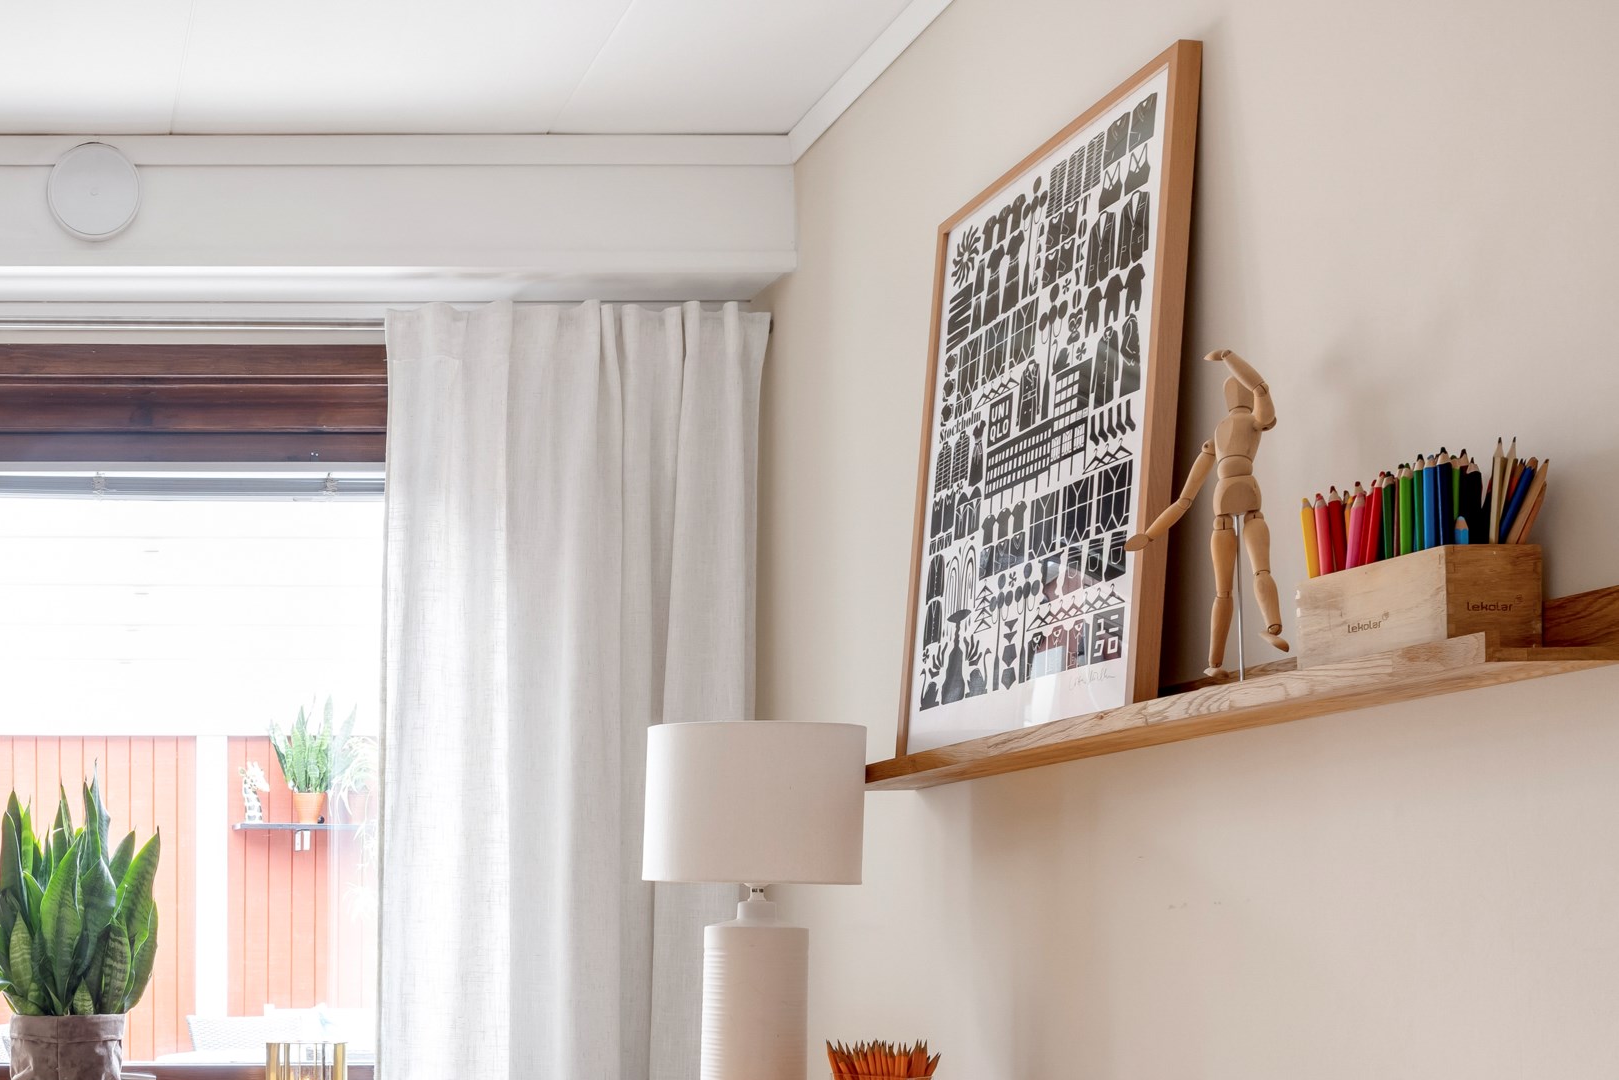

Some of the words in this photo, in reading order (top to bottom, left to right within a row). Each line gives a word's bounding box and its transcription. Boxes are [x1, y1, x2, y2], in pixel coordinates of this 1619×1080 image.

[991, 400, 1009, 422] UNI
[939, 411, 981, 443] Stockholm
[990, 419, 1009, 442] QLO
[1467, 602, 1513, 611] lekolar
[1347, 620, 1382, 633] lekolar
